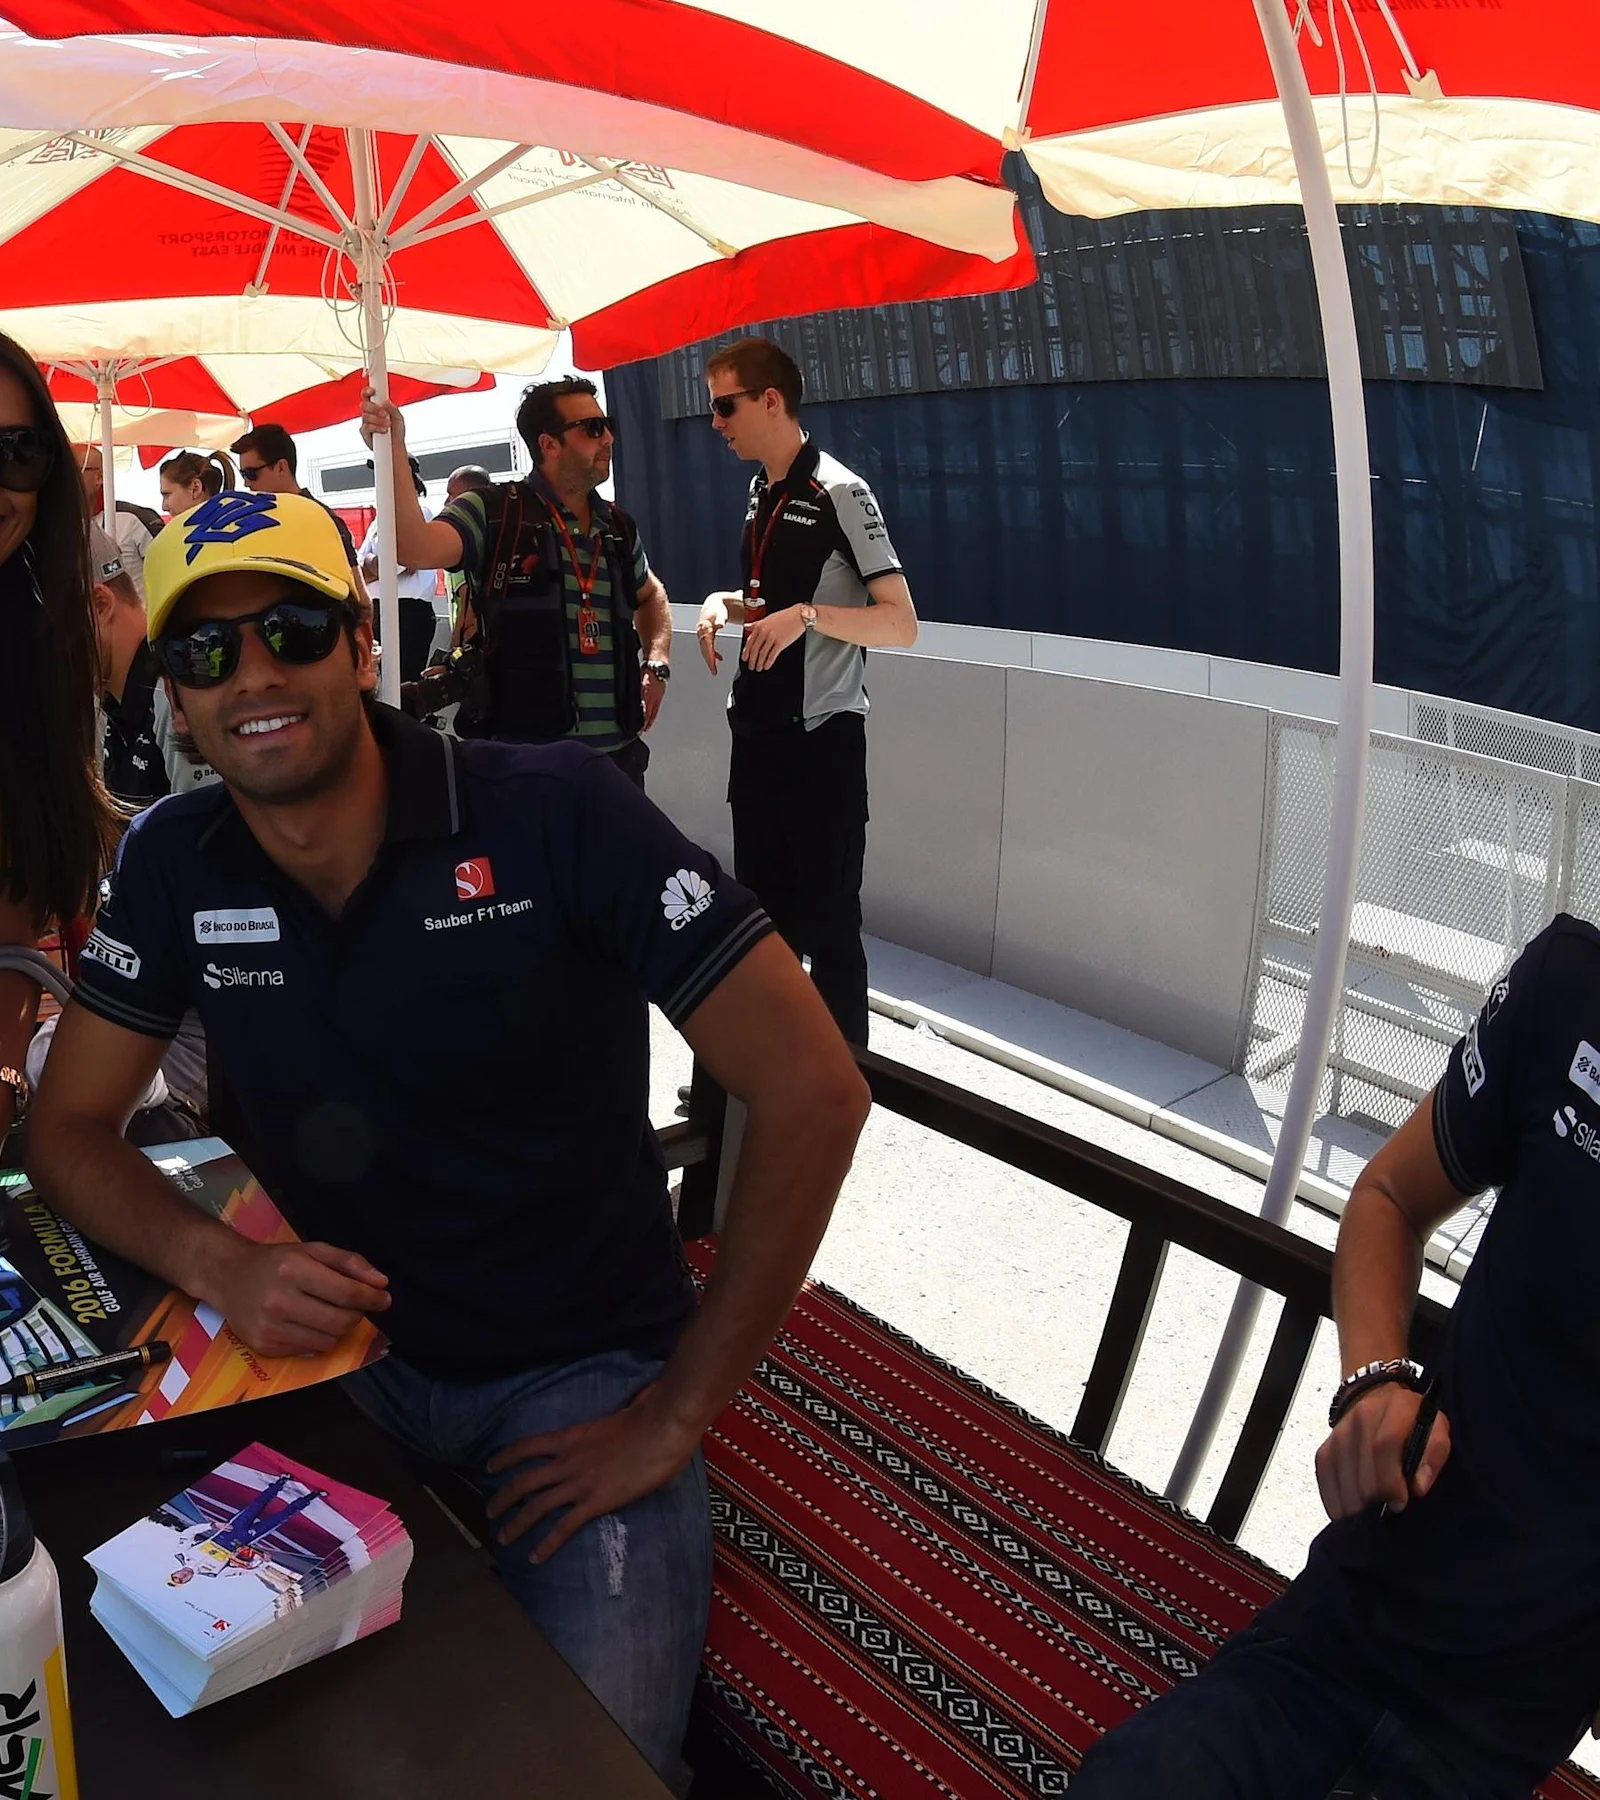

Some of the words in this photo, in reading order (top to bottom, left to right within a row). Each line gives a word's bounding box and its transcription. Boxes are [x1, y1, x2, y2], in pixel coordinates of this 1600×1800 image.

[493, 562, 507, 589] EOS
[248, 919, 276, 932] BRASIL
[423, 913, 475, 931] Sauber
[497, 898, 534, 917] Team
[670, 889, 716, 932] CNBC
[85, 942, 134, 974] RELLI
[221, 967, 285, 986] Silanna
[24, 1202, 82, 1277] FORMULA
[65, 1233, 99, 1272] BAHRAIN
[87, 1271, 108, 1288] AIR
[61, 1278, 108, 1324] 2016
[96, 1289, 122, 1313] GULF
